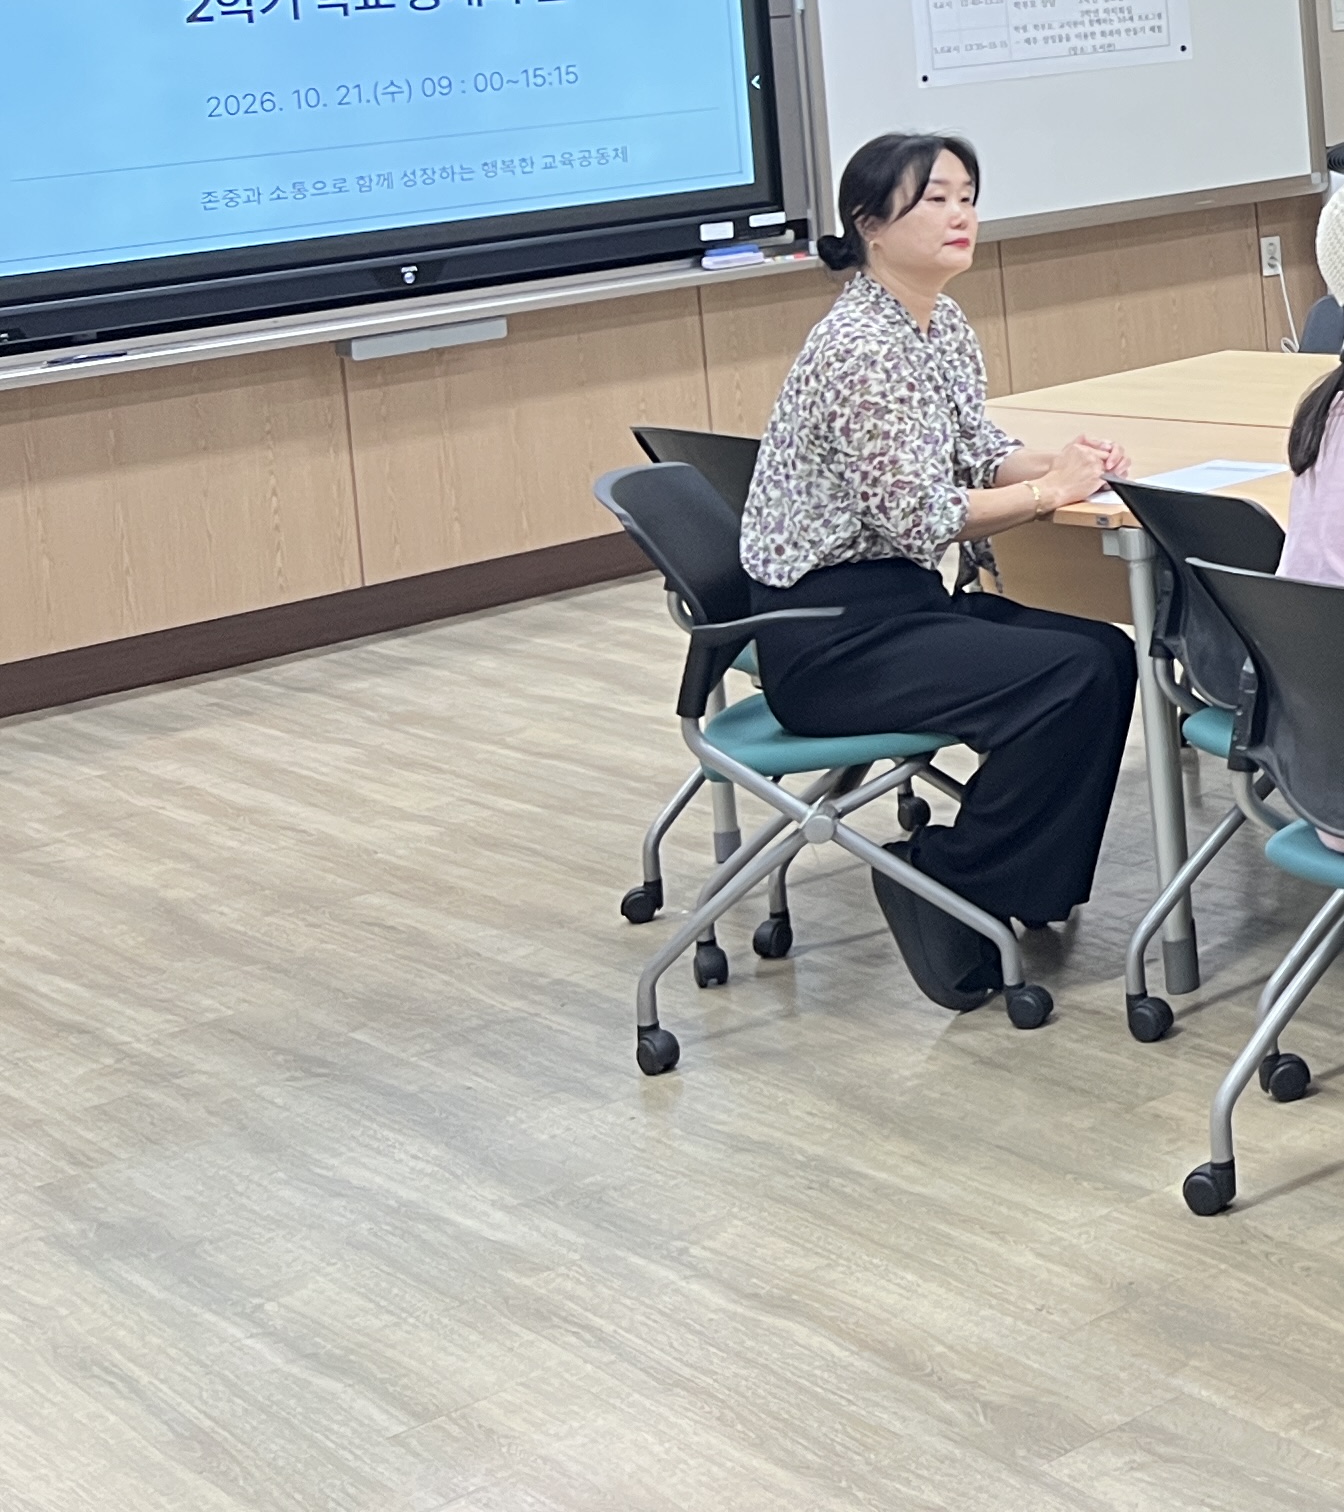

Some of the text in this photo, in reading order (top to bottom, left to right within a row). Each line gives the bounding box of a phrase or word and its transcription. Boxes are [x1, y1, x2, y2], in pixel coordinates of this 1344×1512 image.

[206, 92, 283, 118] 2026.
[292, 88, 328, 109] 10.
[337, 79, 413, 107] 21.(수)
[421, 76, 453, 97] 09
[473, 66, 580, 93] 00~15:15
[201, 146, 629, 211] 존중과 소통으로 함께 성장하는 행복한 교육공동체
